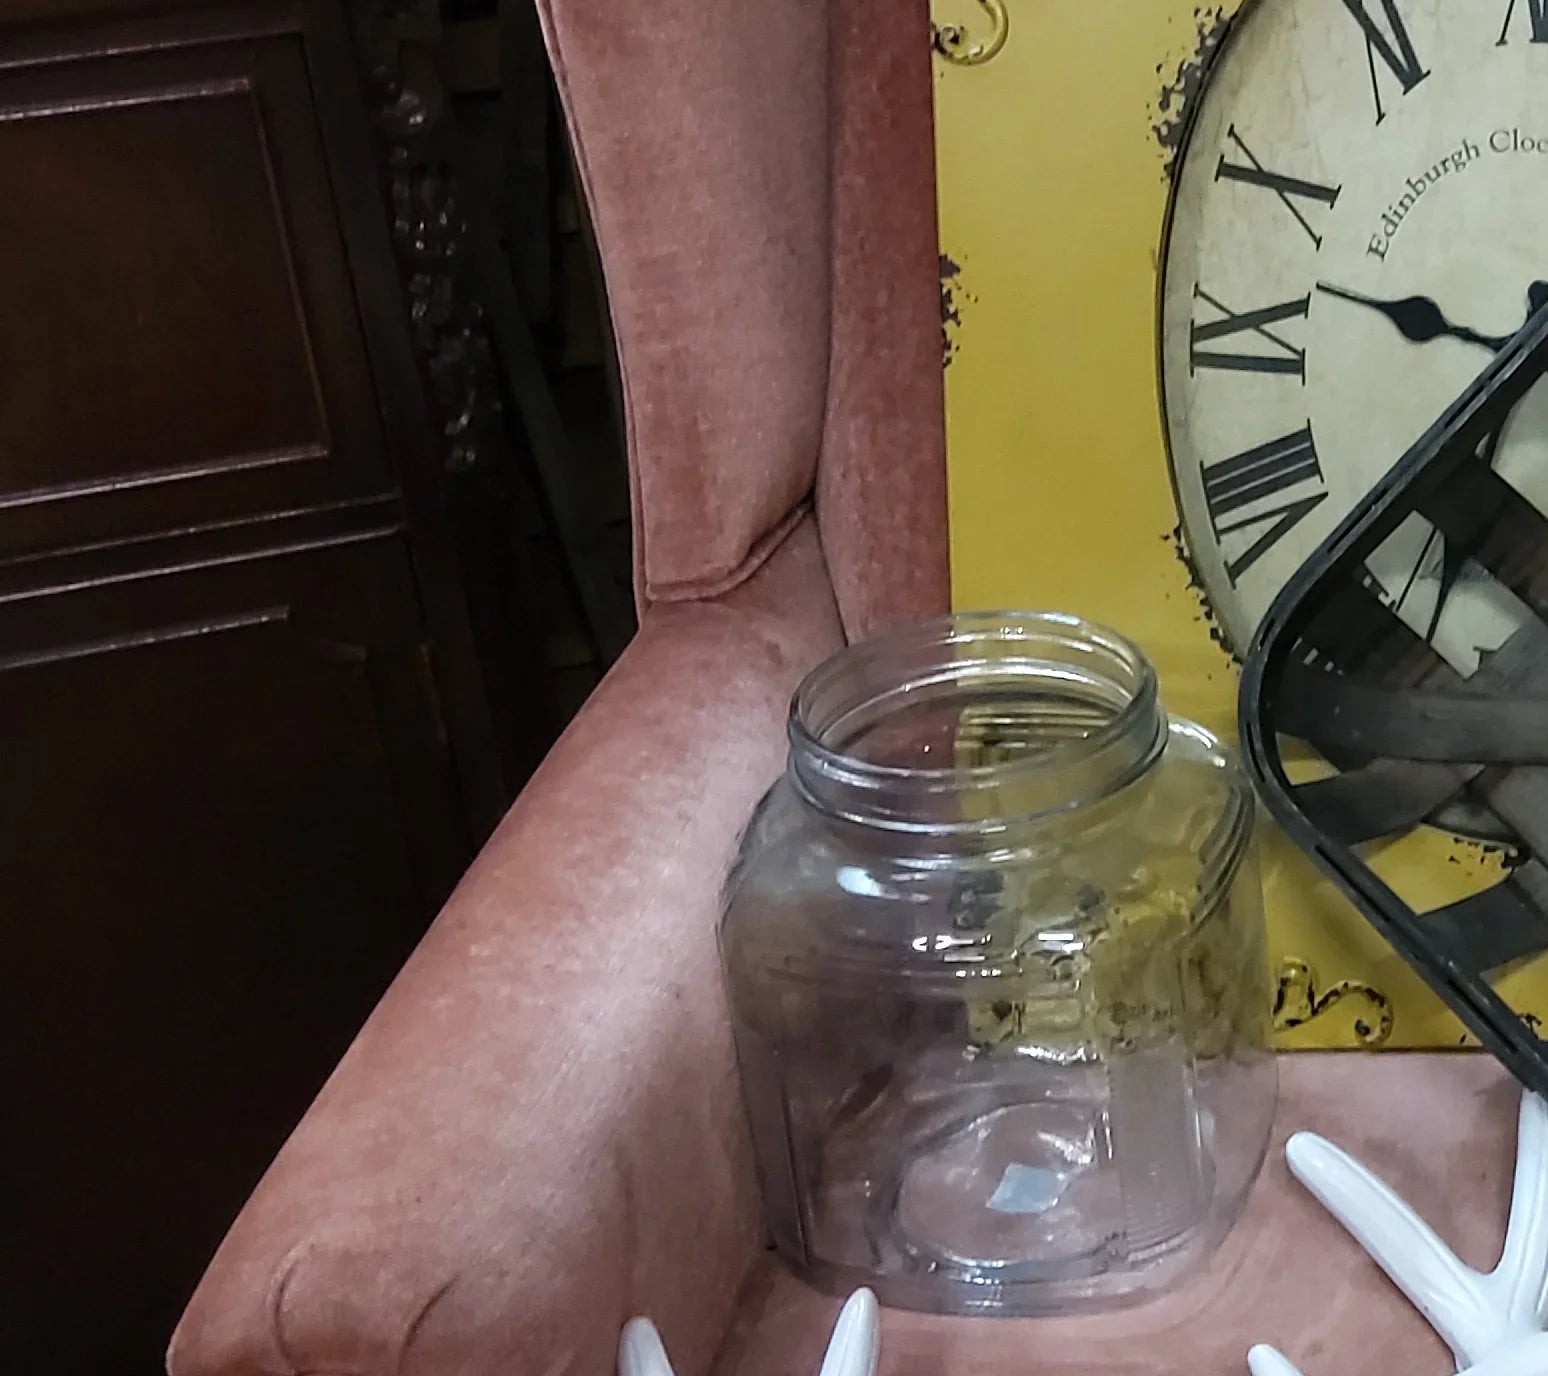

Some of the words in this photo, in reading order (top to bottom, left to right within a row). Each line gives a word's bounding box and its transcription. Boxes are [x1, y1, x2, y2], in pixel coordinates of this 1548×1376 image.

[1215, 124, 1341, 251] X
[1366, 138, 1480, 263] Edinburgh
[1190, 282, 1311, 386] IX
[1200, 419, 1331, 590] VIII
